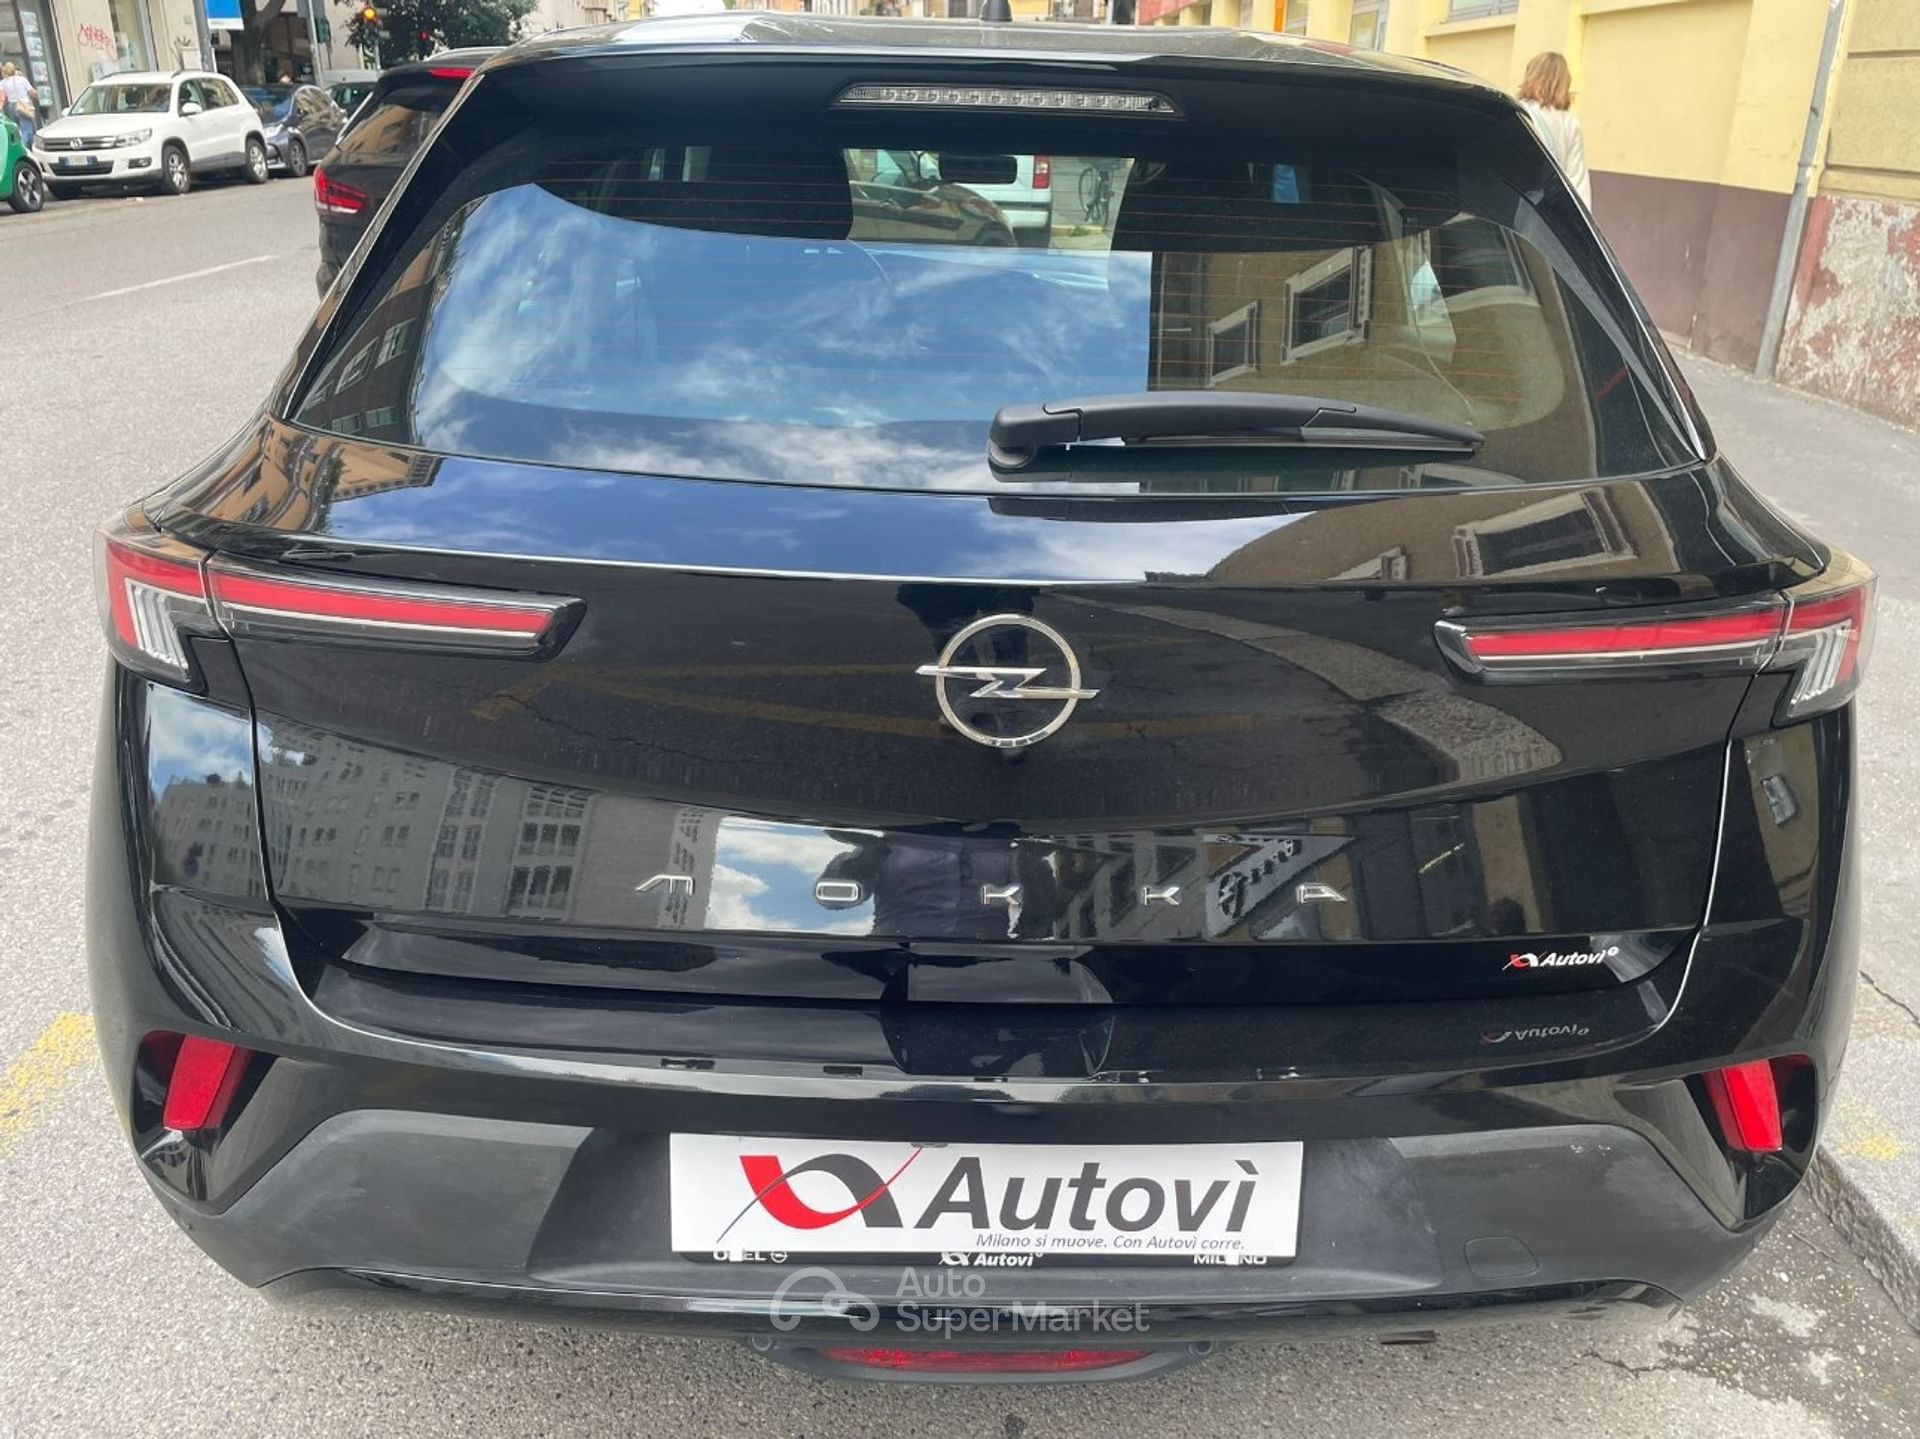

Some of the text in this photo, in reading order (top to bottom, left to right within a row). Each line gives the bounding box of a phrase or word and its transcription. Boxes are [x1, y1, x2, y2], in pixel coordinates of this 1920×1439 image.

[635, 874, 1348, 906] MOKKA
[914, 1156, 1260, 1232] Autovì
[976, 1234, 1246, 1250] Milano si muove. Con Autovì corre.
[713, 1251, 766, 1261] OEL
[1193, 1254, 1267, 1265] MILNO
